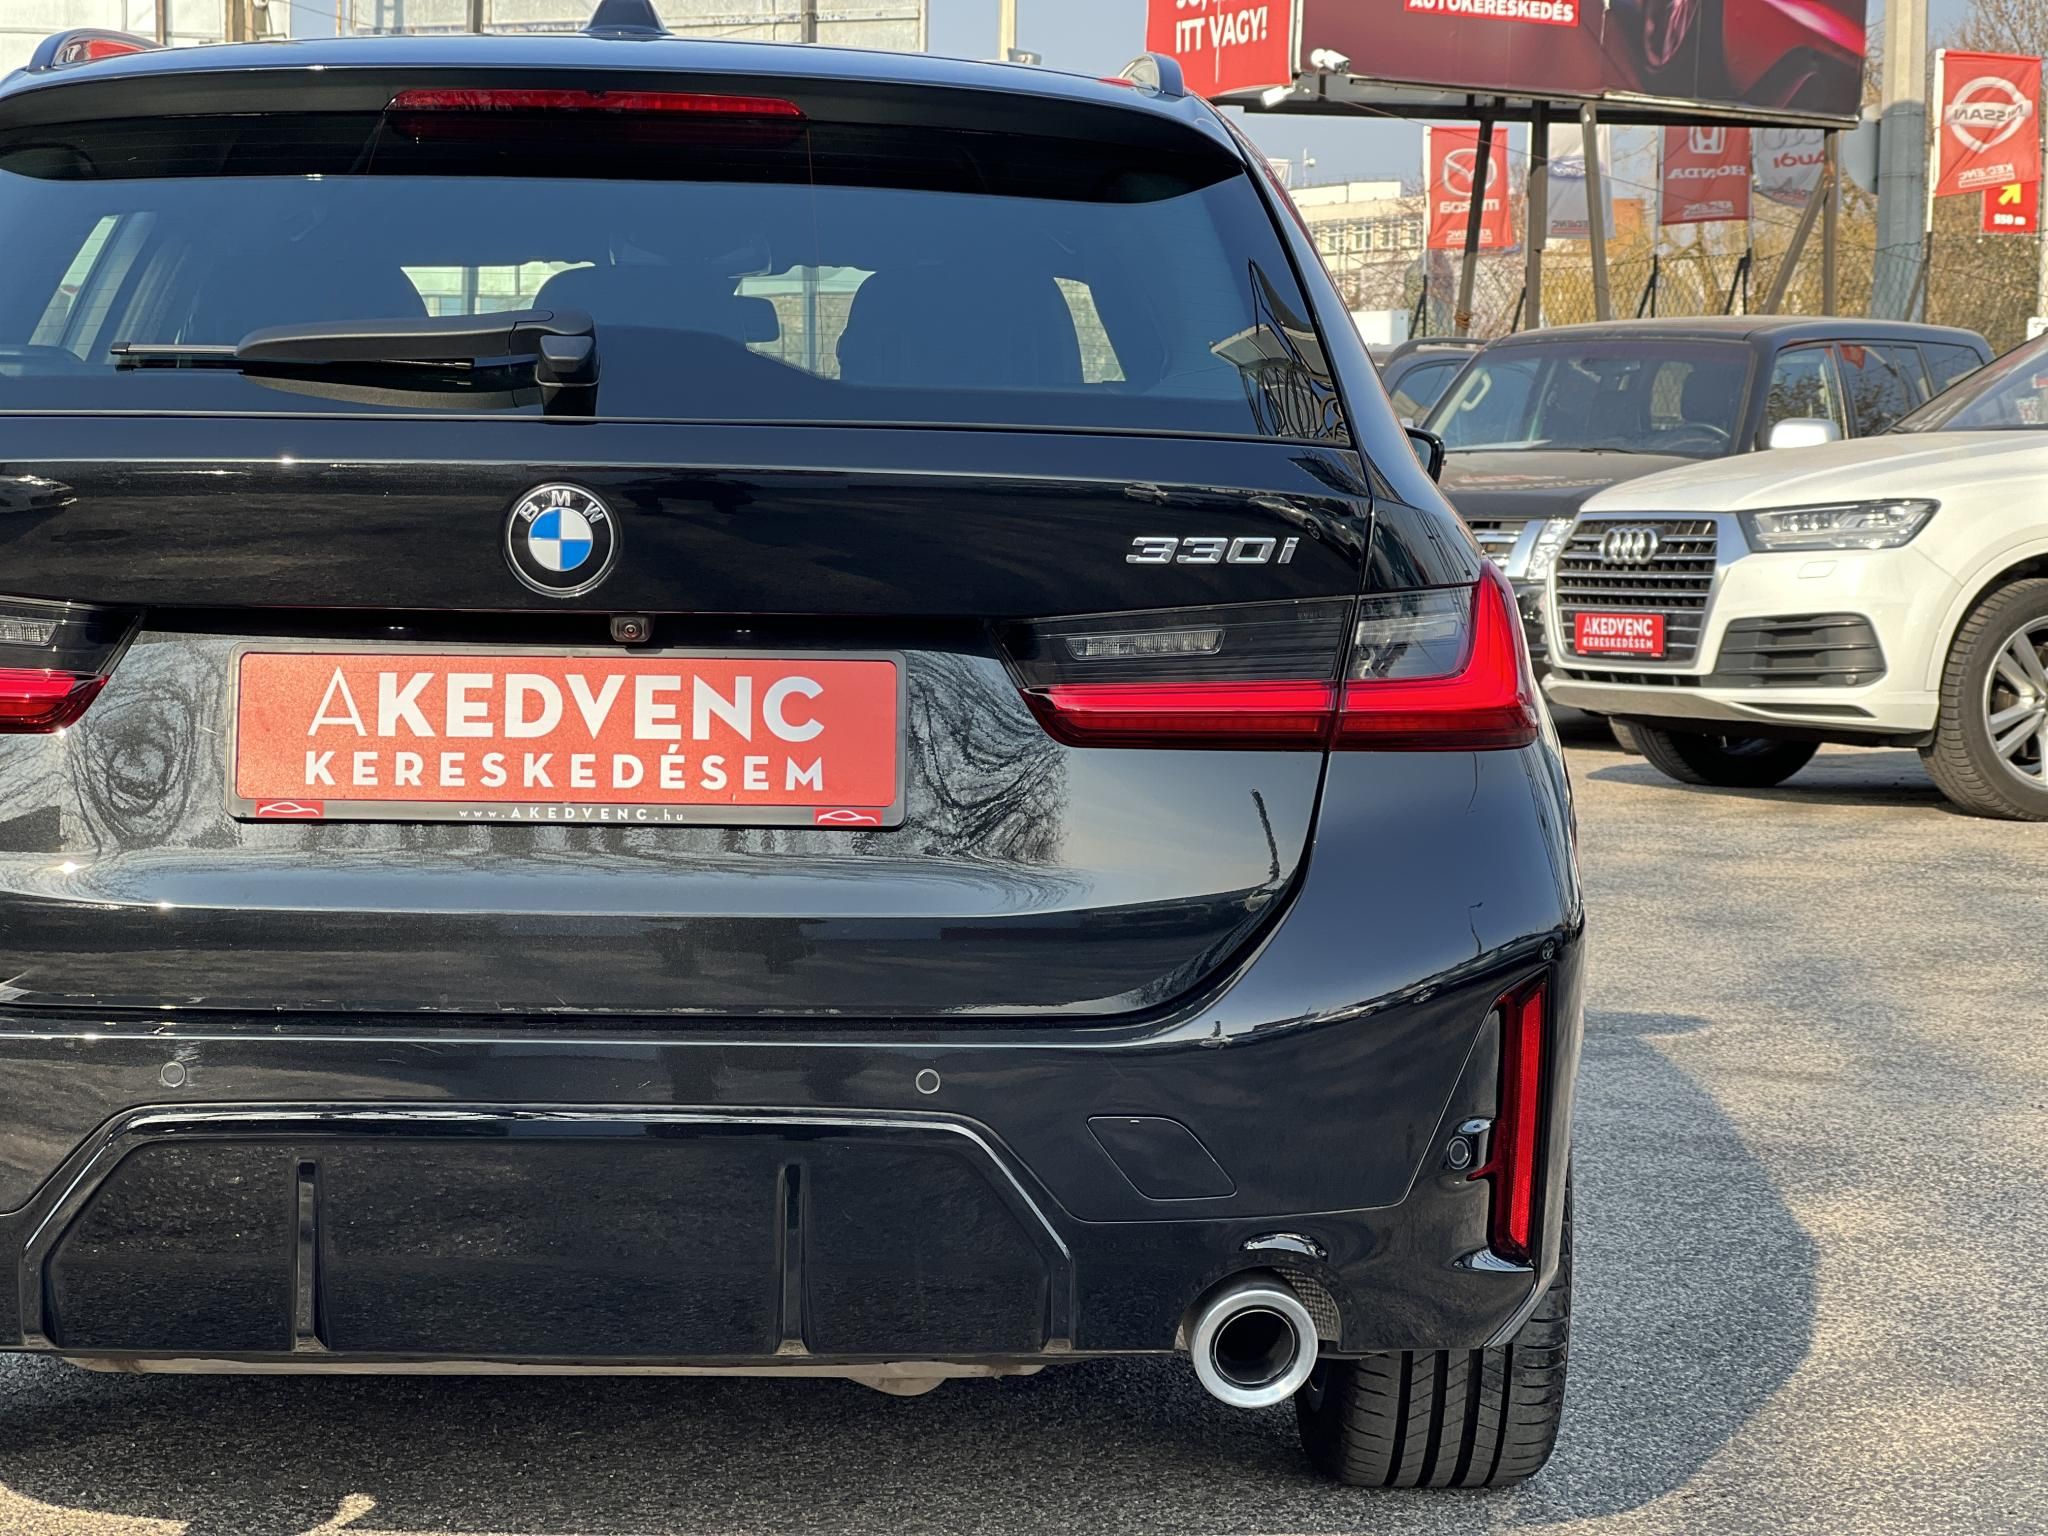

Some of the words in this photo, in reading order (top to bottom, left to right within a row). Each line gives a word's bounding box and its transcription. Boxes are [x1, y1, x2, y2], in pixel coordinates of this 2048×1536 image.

[1175, 17, 1206, 54] ITT
[1208, 6, 1268, 48] VAGY!
[519, 490, 605, 524] BMW
[1125, 536, 1301, 564] 330i
[1582, 616, 1654, 637] AKEDVENC
[1582, 636, 1654, 650] KERESKEDÉSEM
[307, 665, 825, 743] AKEDVENC
[305, 744, 824, 792] KERESKEDÉSEM
